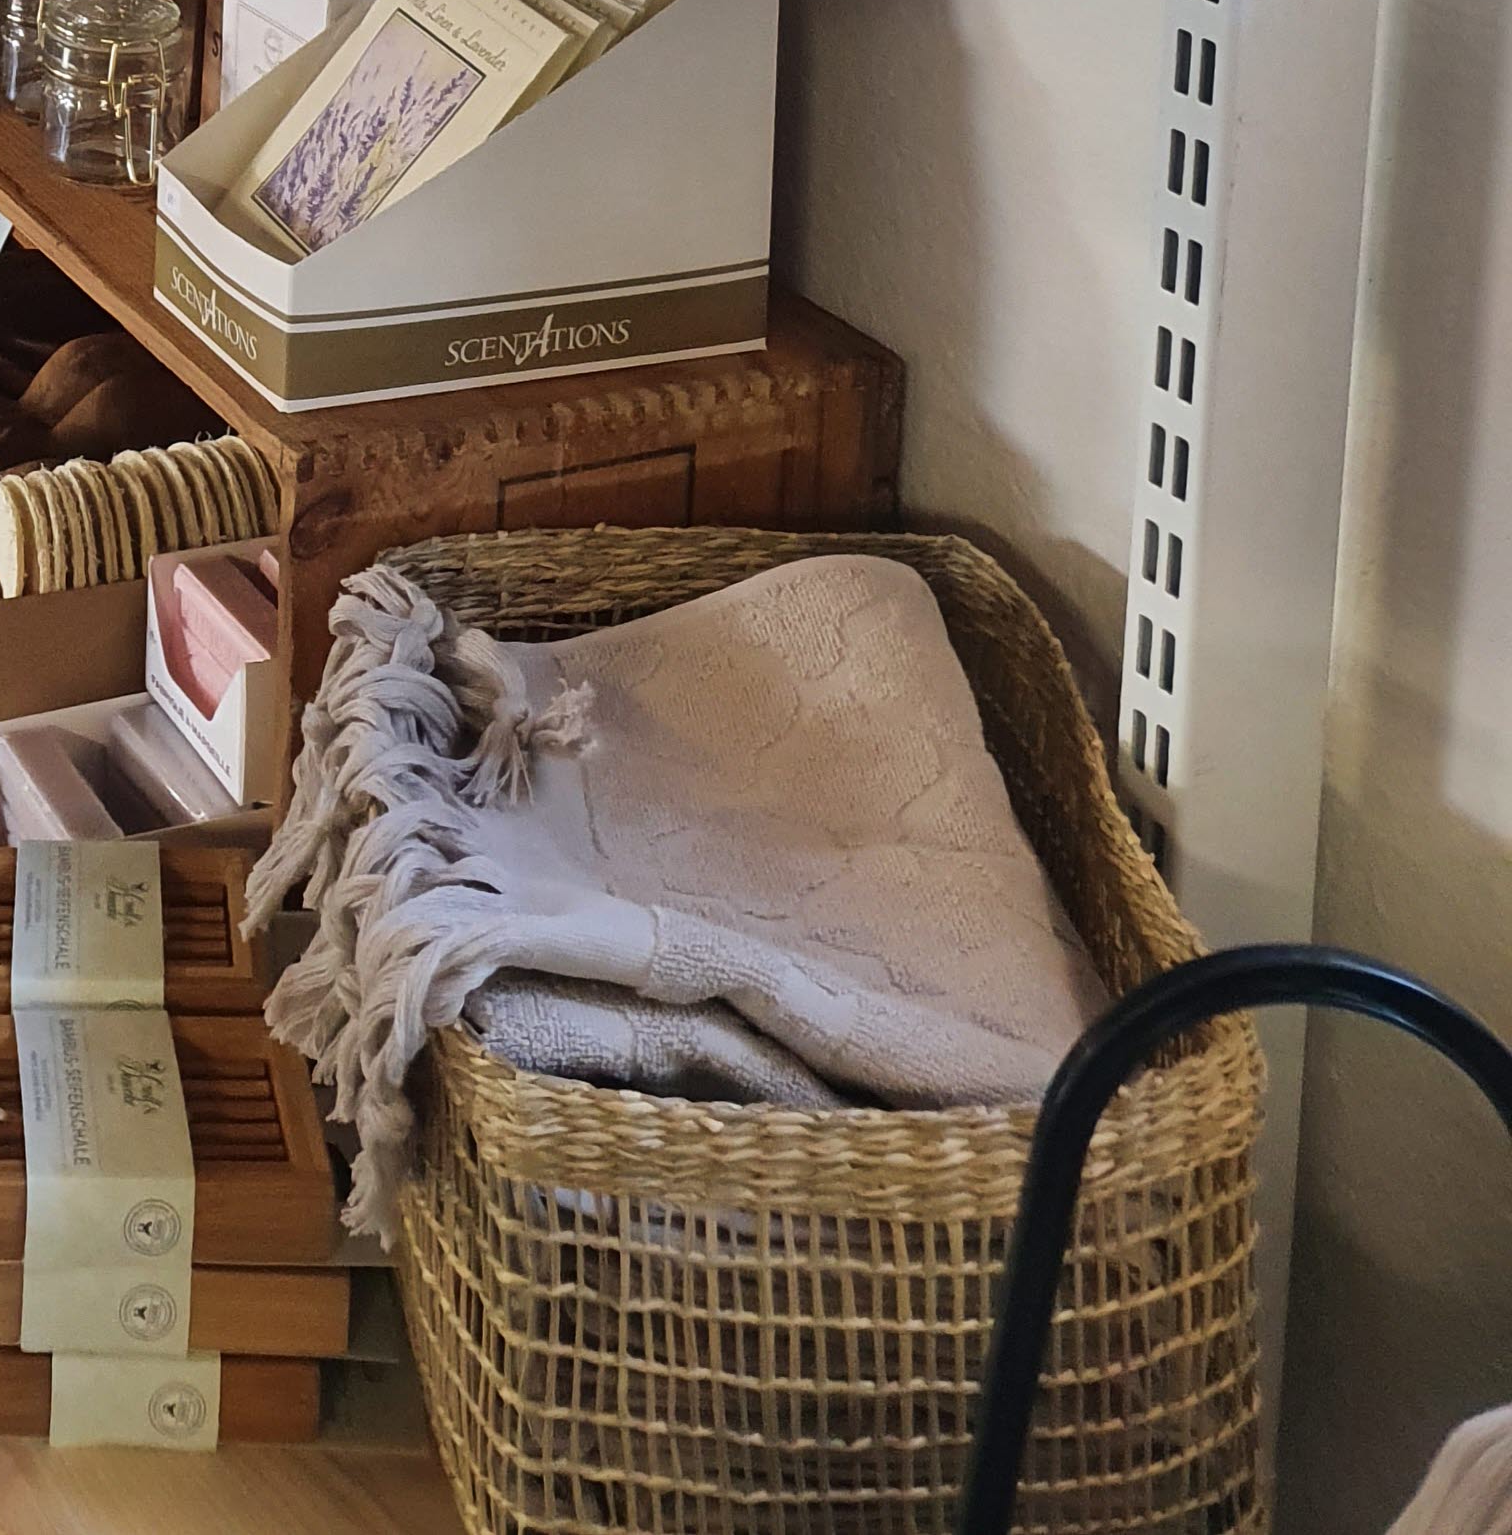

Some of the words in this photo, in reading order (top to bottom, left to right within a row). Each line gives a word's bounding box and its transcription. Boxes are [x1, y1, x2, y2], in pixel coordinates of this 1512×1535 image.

[460, 28, 507, 72] Lavender
[170, 266, 258, 361] SCENTATIONS
[444, 313, 632, 367] SCENTATIONS
